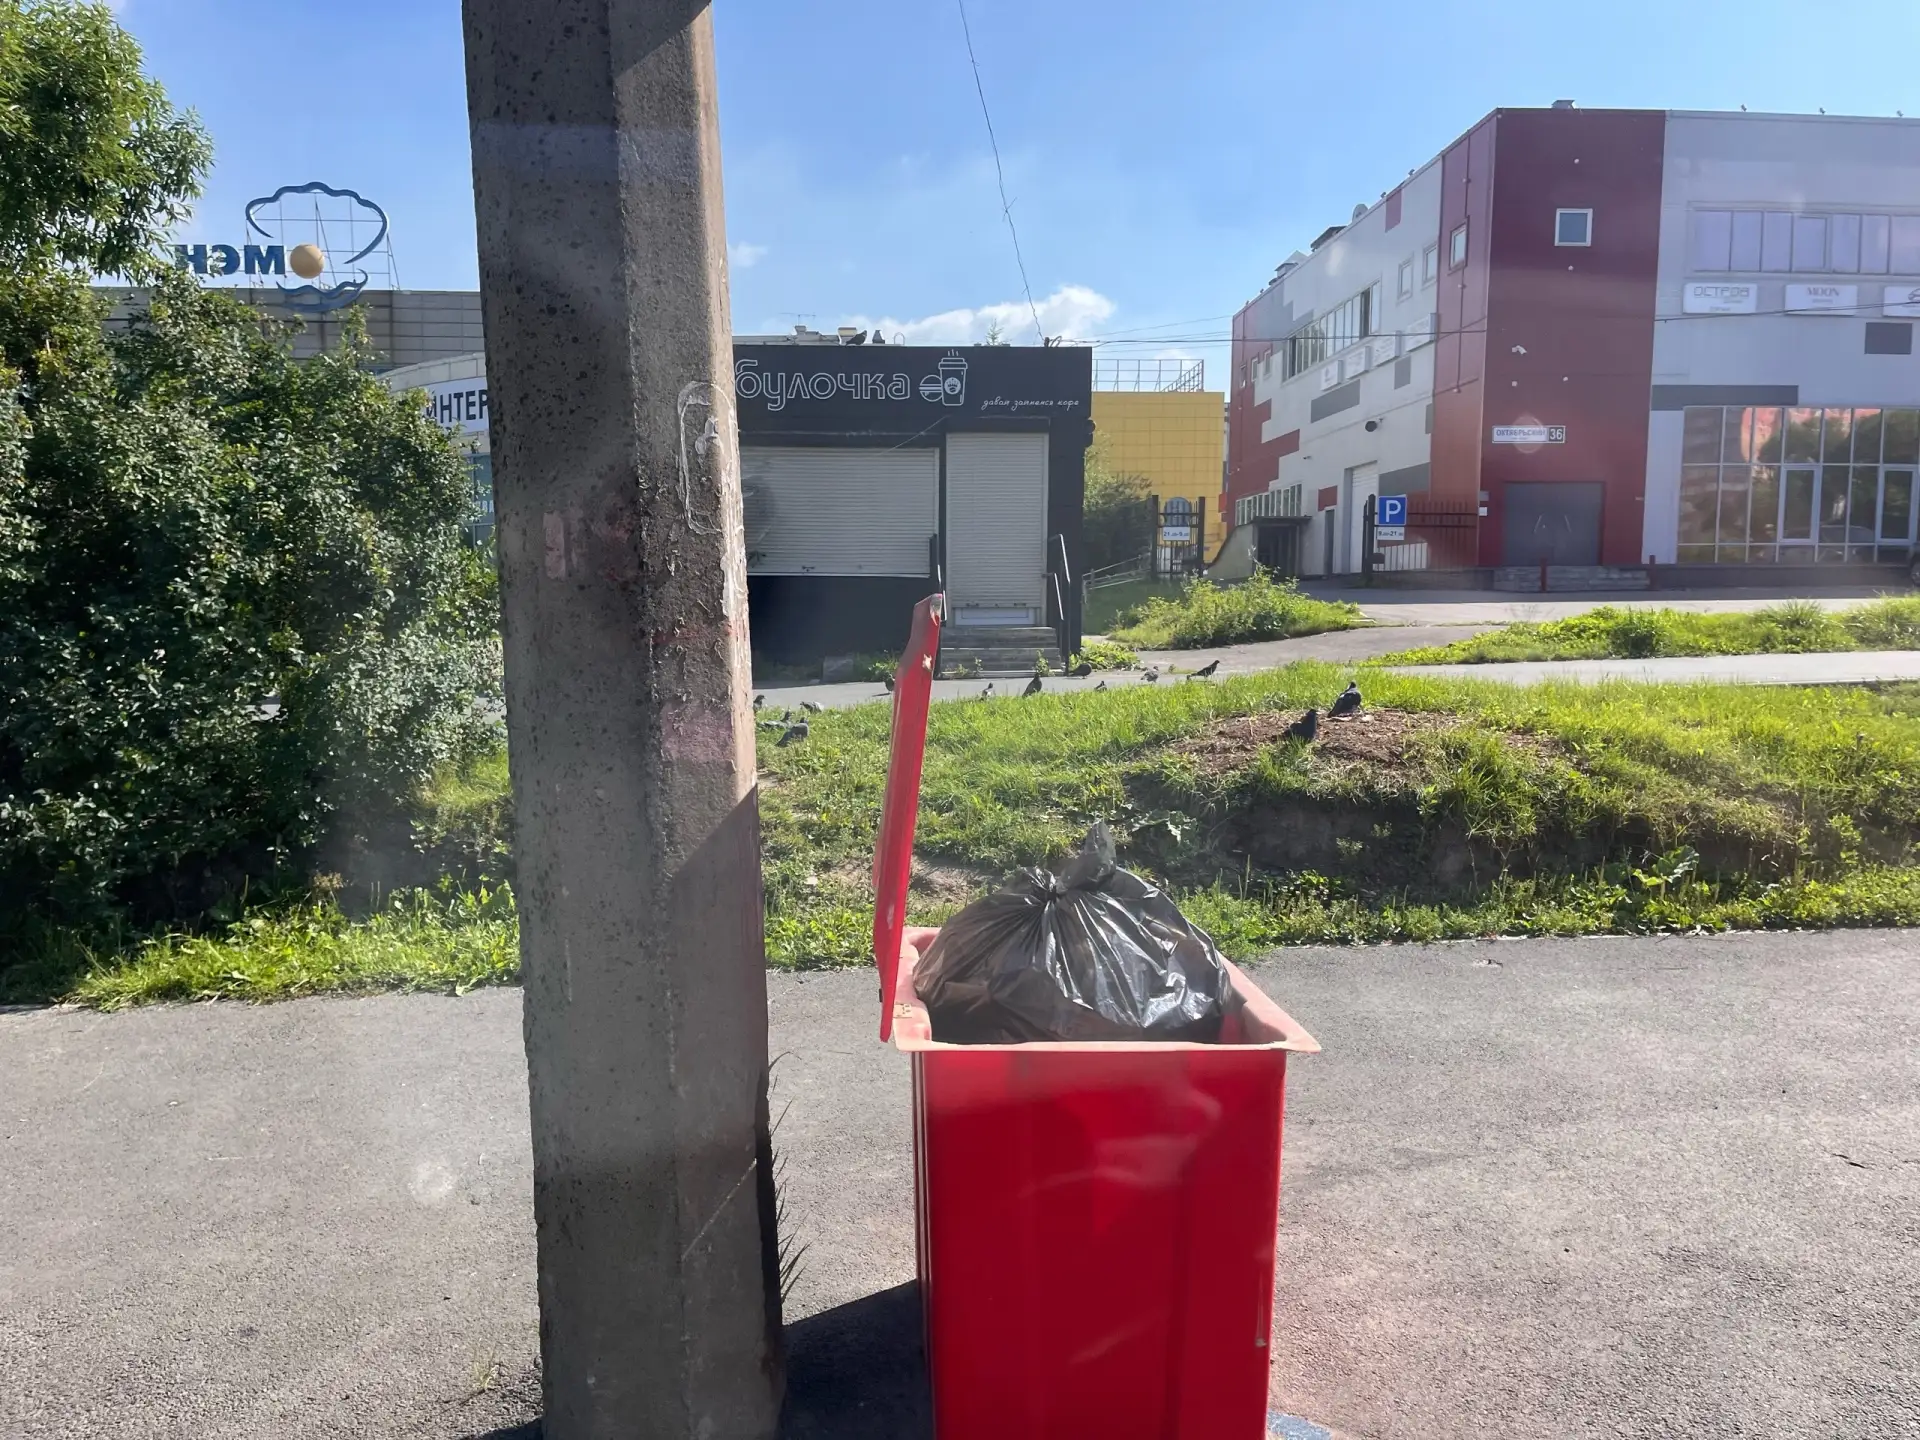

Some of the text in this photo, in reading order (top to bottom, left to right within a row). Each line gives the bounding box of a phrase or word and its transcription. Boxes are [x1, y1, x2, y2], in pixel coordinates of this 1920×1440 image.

[735, 359, 911, 411] булочка
[1057, 399, 1080, 412] кофе
[1549, 428, 1563, 440] 36
[1385, 499, 1402, 523] P
